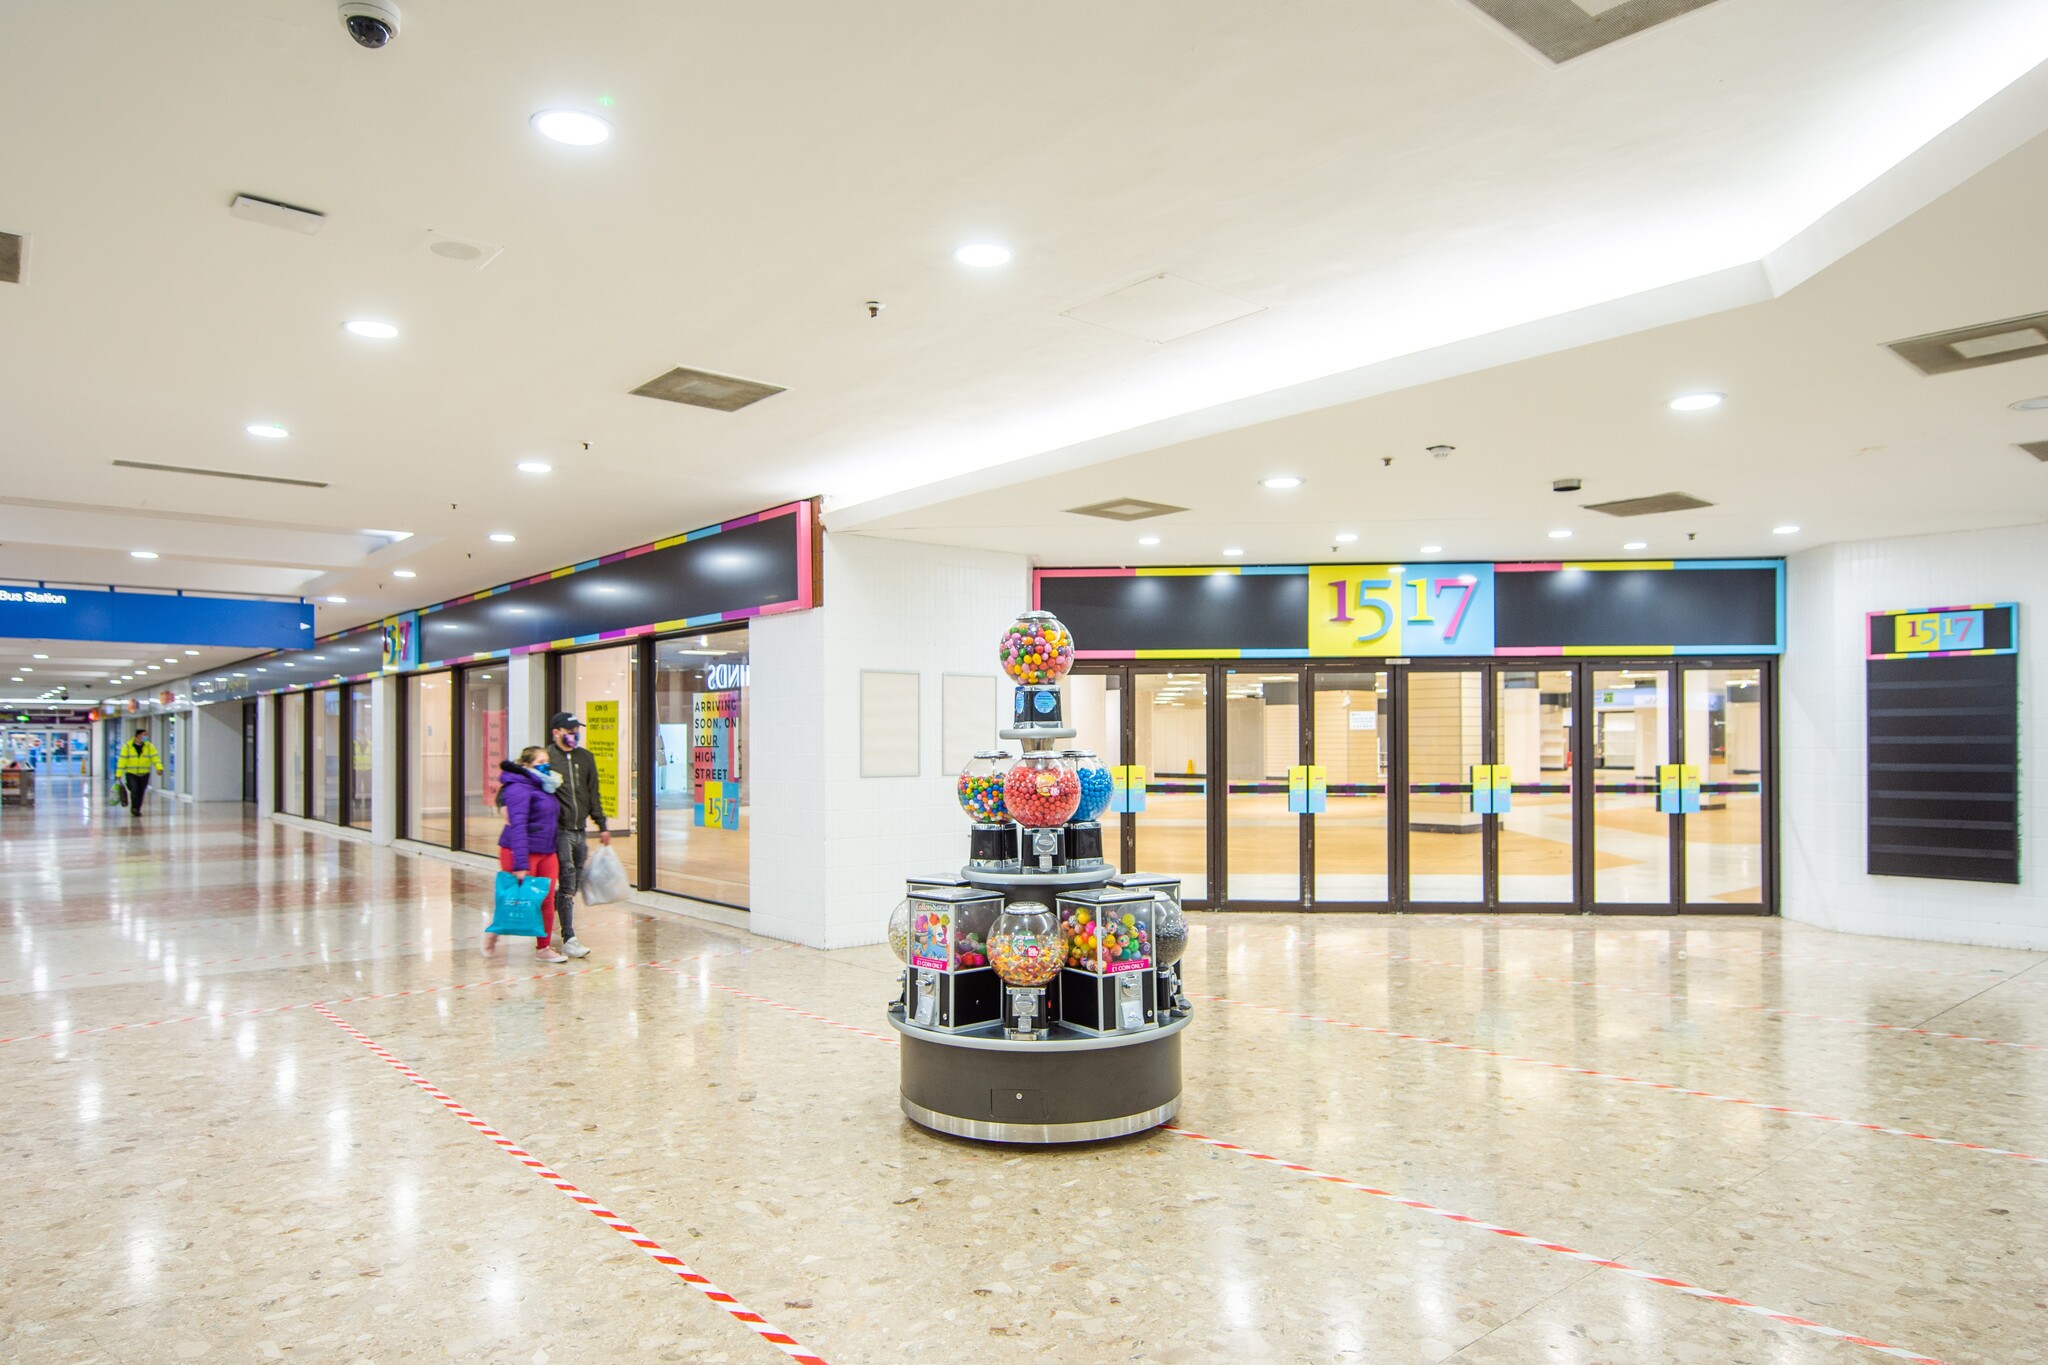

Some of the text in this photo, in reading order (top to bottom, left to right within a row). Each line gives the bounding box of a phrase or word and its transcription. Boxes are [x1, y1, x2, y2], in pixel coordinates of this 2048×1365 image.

[0, 590, 67, 604] Bus Station
[1328, 578, 1478, 643] 1517
[1907, 617, 1975, 645] 1517
[694, 700, 737, 713] ARRIVING
[694, 717, 737, 729] SOON, ON
[694, 735, 718, 746] YOUR
[695, 751, 716, 763] HIGH
[694, 768, 728, 780] STREET
[708, 797, 737, 824] 1517
[932, 962, 943, 970] ONLY
[1131, 962, 1145, 970] ONLY
